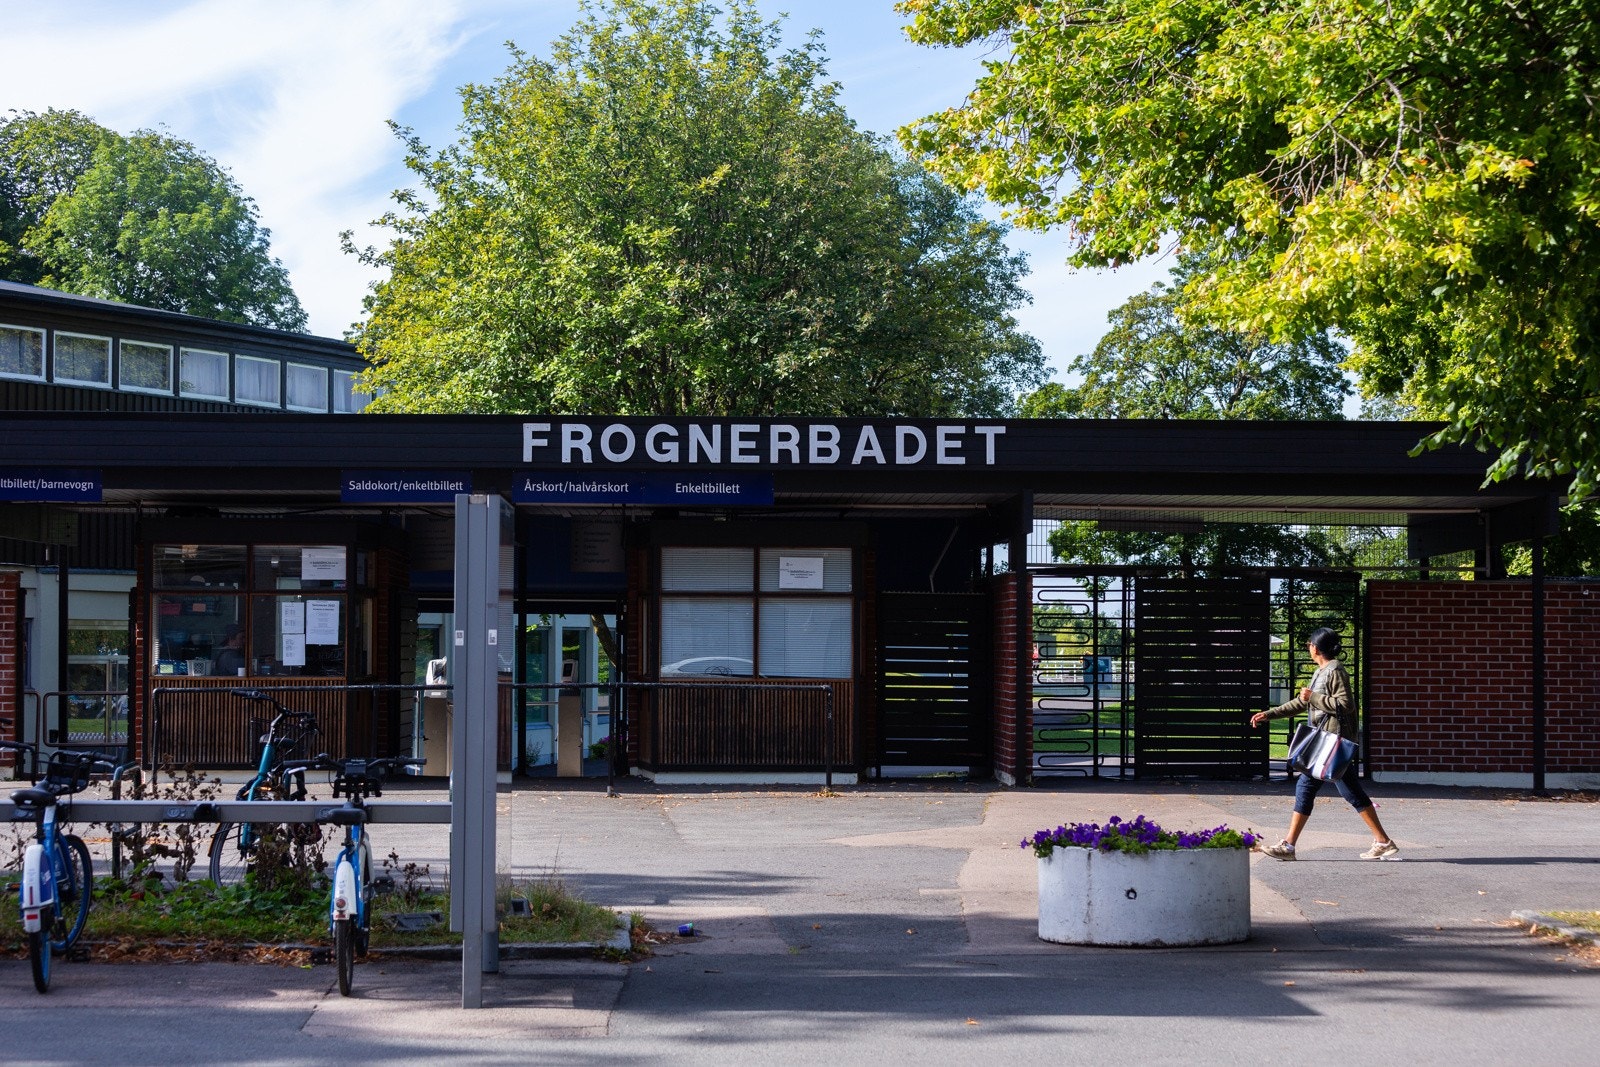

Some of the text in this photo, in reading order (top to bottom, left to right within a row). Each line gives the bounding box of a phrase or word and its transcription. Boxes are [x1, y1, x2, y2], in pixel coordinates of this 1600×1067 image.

[522, 423, 1007, 466] FROGNERBADET
[348, 480, 464, 492] Saldokort/enkeltbillett
[524, 481, 629, 493] Årskort/halvårskort
[675, 482, 740, 494] Enkeltbillett
